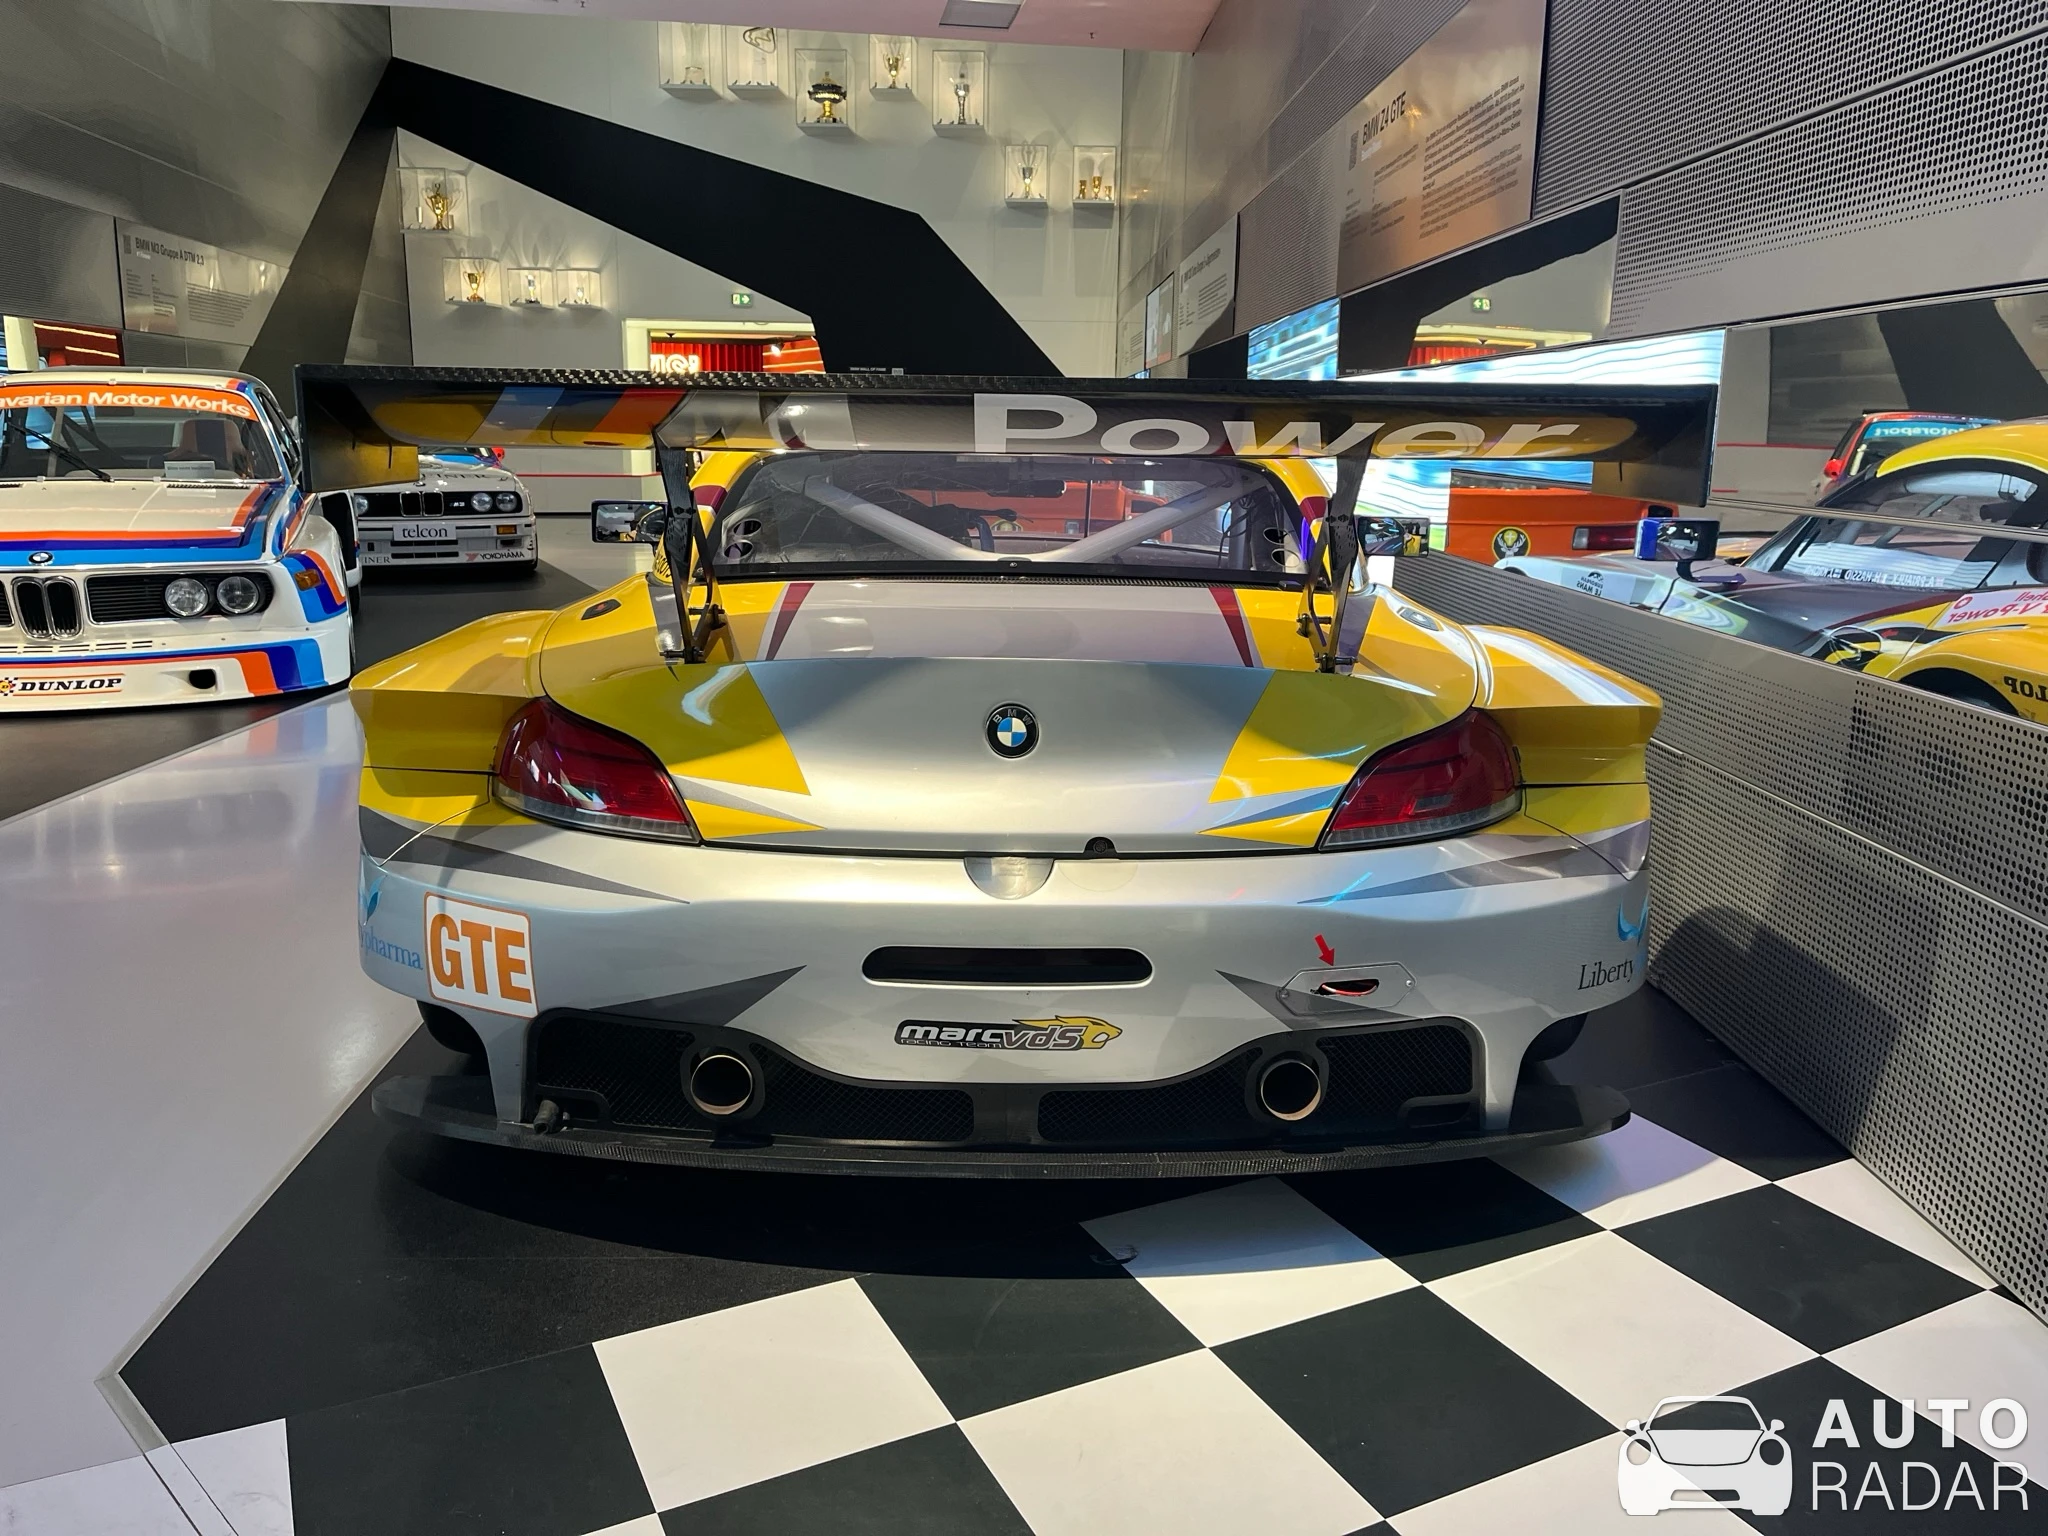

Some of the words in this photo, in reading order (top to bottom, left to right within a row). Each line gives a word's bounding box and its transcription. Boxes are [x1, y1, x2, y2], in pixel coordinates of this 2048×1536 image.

[1380, 104, 1390, 132] Z4
[1391, 90, 1407, 123] GTE
[0, 392, 82, 406] varian
[87, 391, 166, 406] Motor
[170, 393, 251, 417] Works
[973, 392, 1580, 457] Power
[402, 524, 448, 538] telcon
[480, 551, 525, 560] YOKOHAMA
[18, 678, 122, 691] DUNLOP
[430, 913, 533, 1003] GTE
[1578, 958, 1634, 990] Liberty
